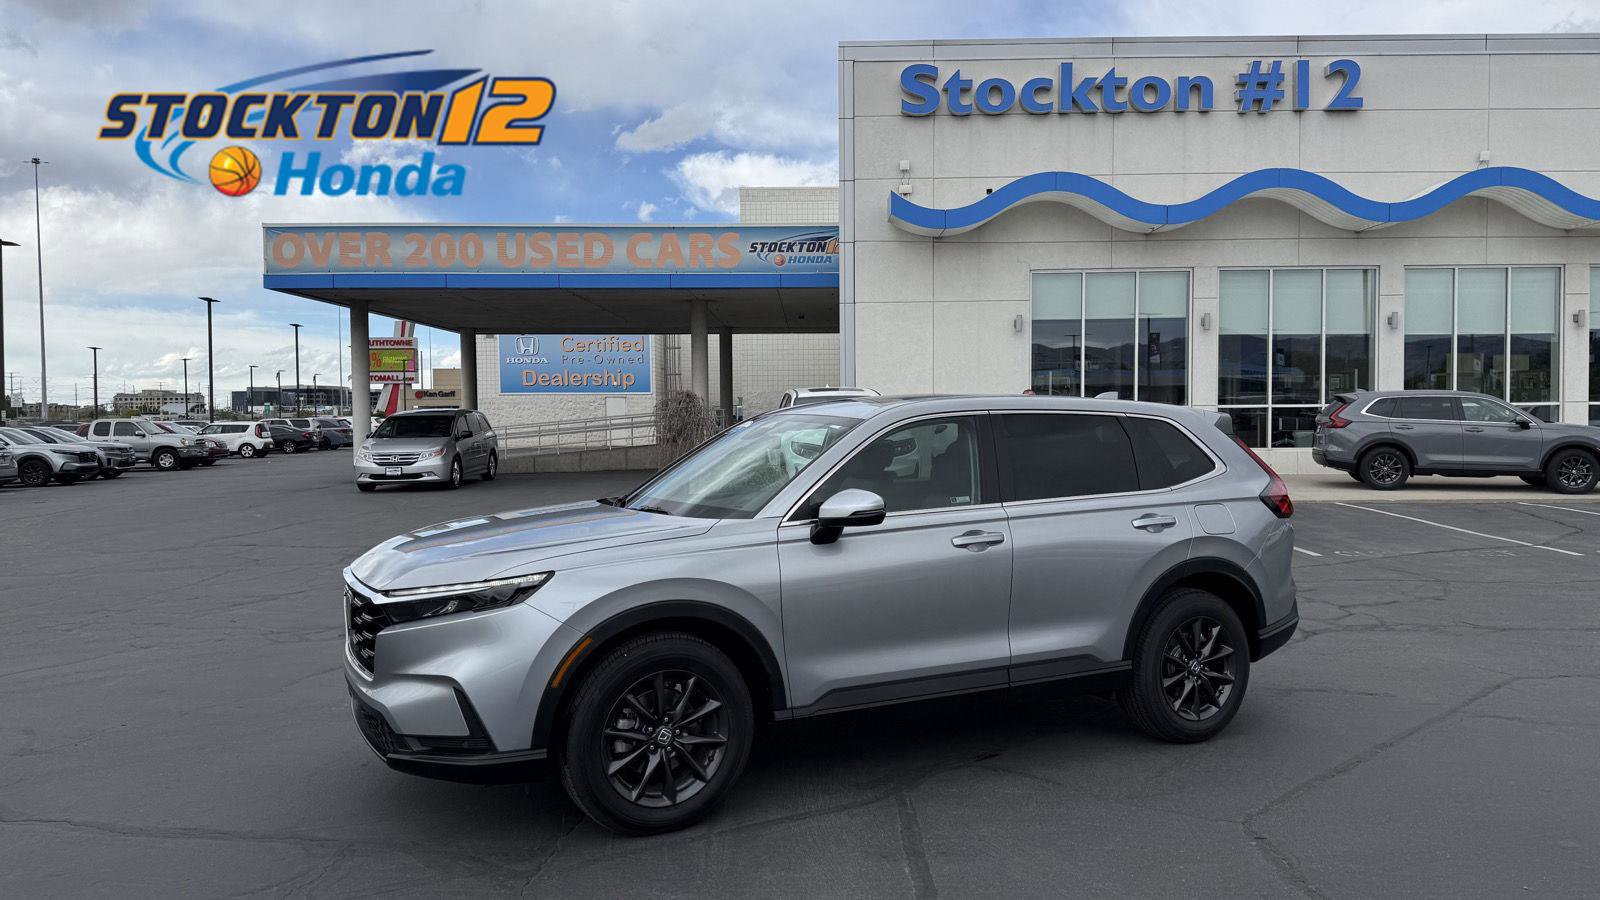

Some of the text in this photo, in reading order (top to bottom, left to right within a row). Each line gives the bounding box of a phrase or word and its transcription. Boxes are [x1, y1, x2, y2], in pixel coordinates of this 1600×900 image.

[899, 62, 1215, 117] Stockton
[272, 231, 741, 269] OVER 200 USED CARS
[748, 241, 827, 253] STOCKTON
[788, 256, 832, 264] HONDA
[368, 339, 413, 347] UTHTOWNE
[559, 335, 645, 353] Certified
[506, 356, 549, 365] HONDA
[561, 354, 645, 365] Pre-Owned
[521, 368, 636, 390] Dealership
[438, 390, 455, 398] Garff
